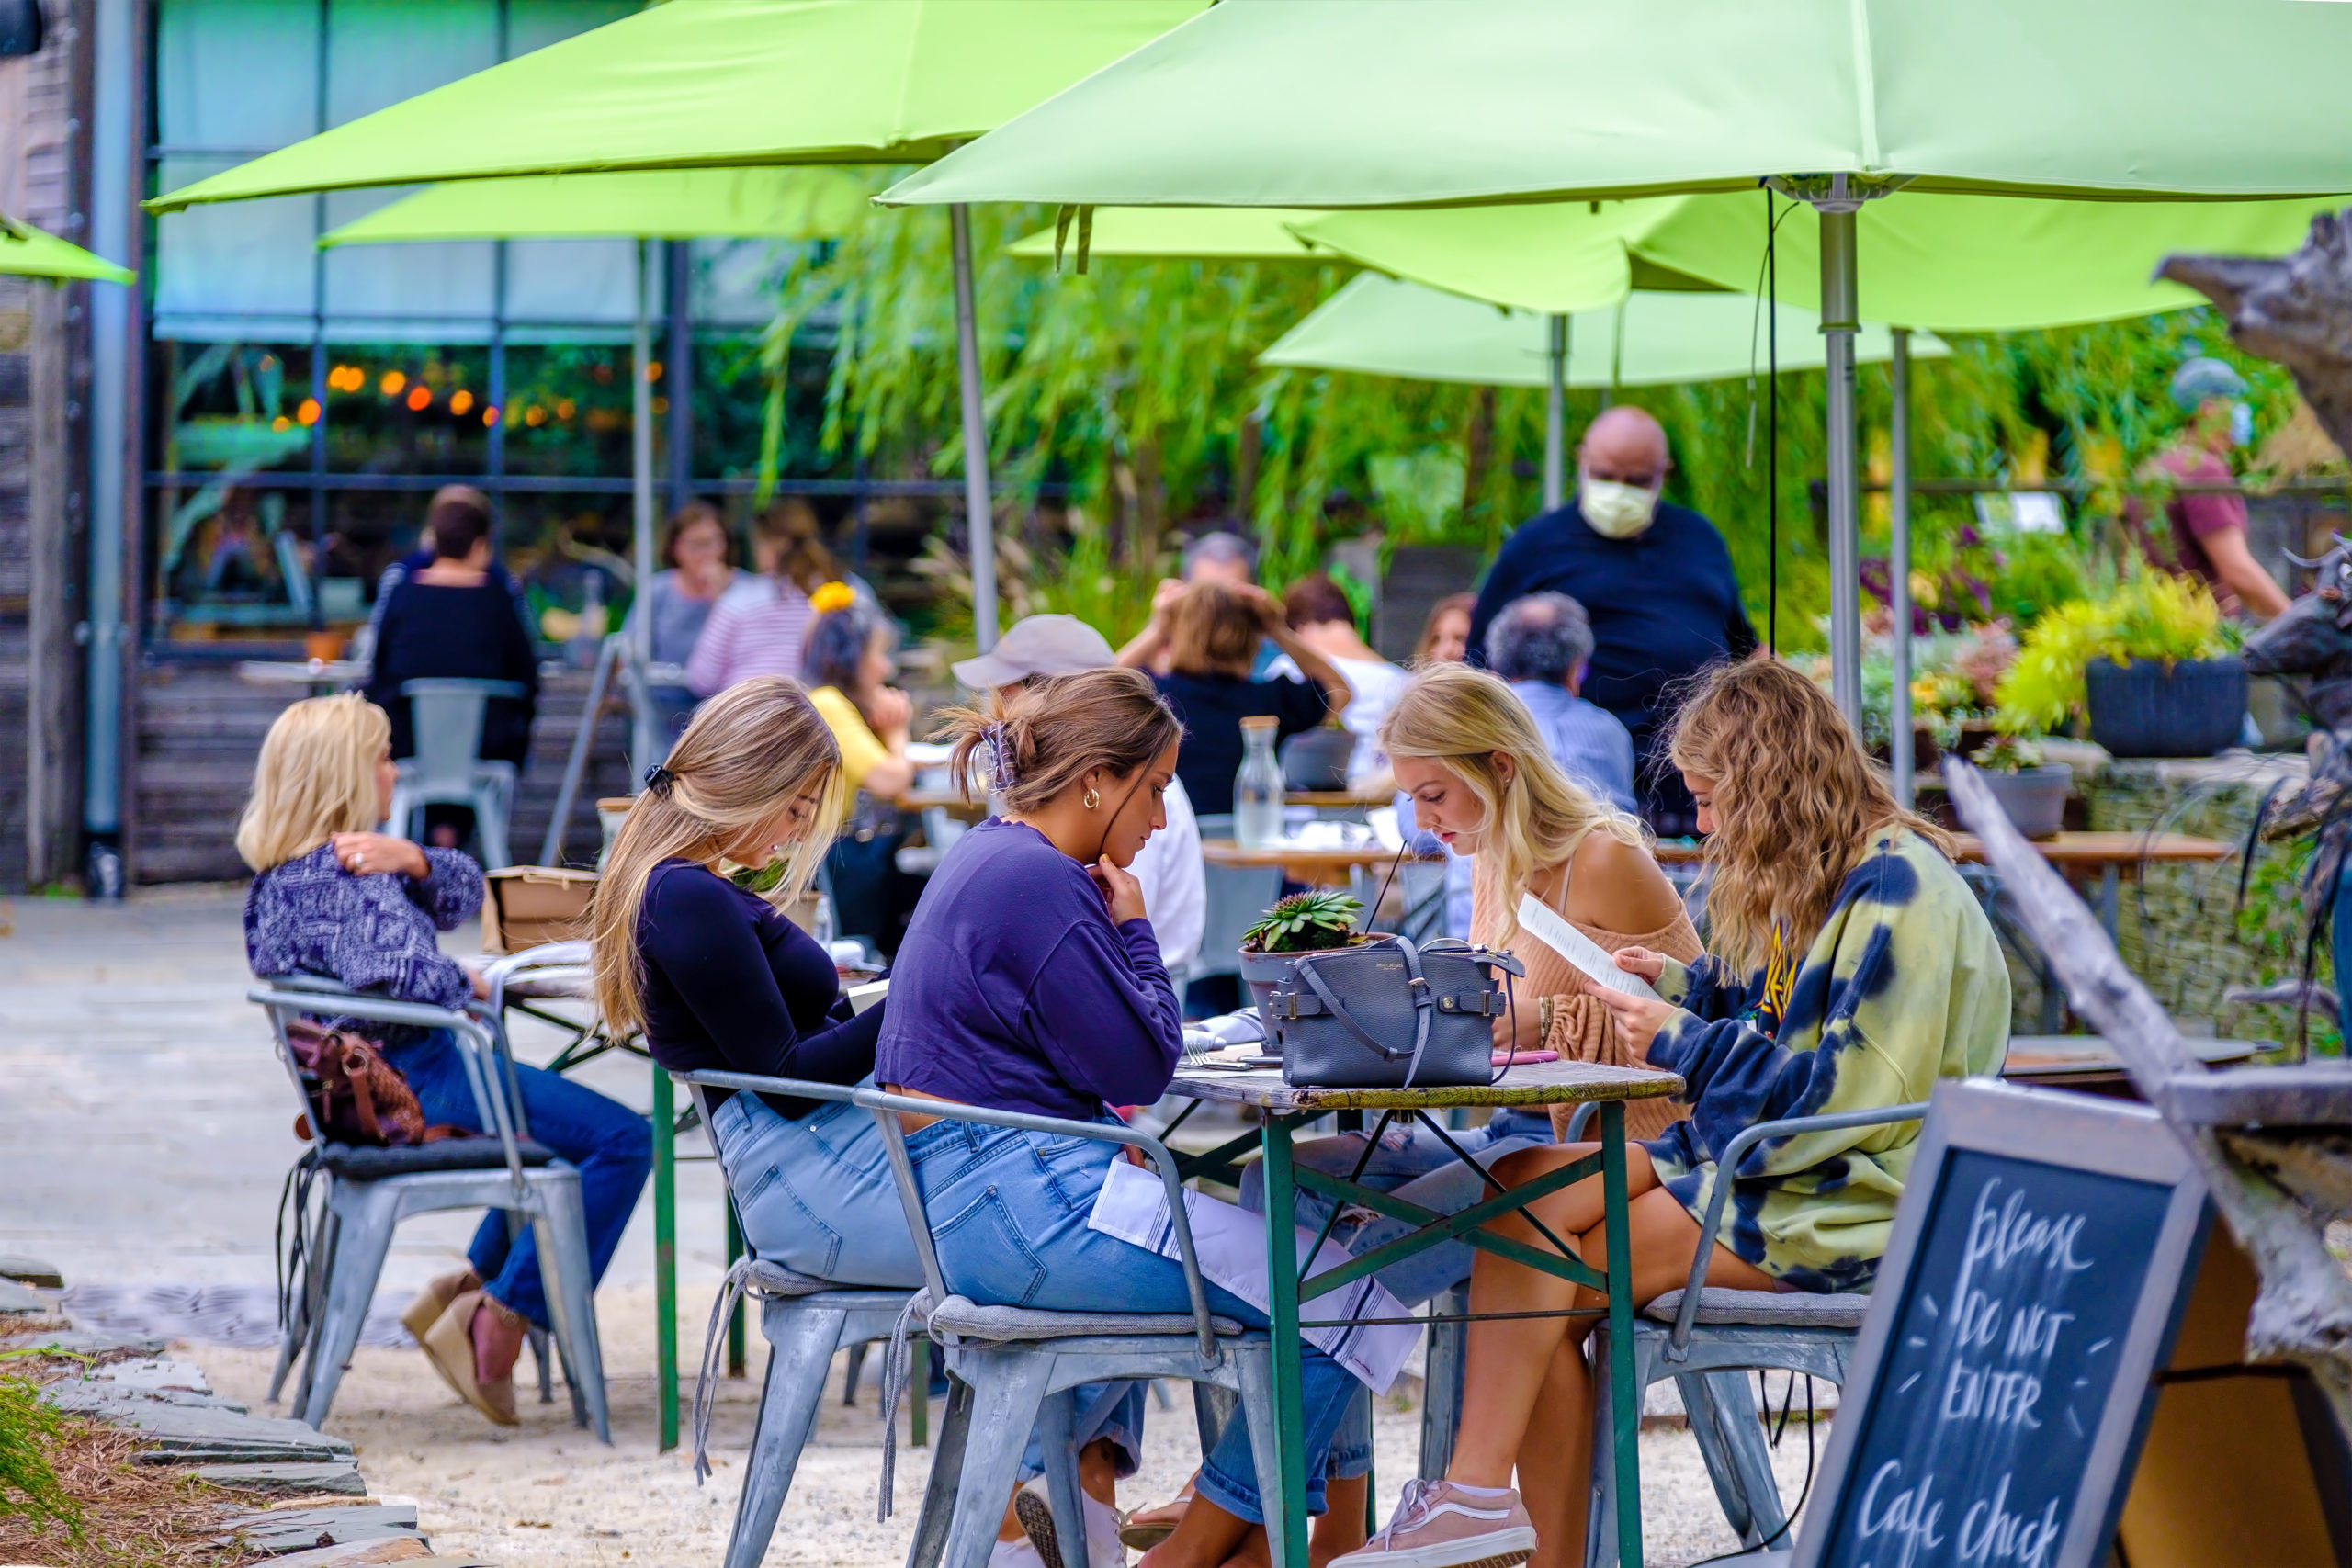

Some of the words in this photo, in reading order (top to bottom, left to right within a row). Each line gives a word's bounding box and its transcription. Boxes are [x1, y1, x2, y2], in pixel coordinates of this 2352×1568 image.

[1958, 1289, 2002, 1348] DO
[2007, 1302, 2075, 1358] NOT
[1939, 1358, 2042, 1428] ENTER
[1856, 1458, 1946, 1568] Cafe
